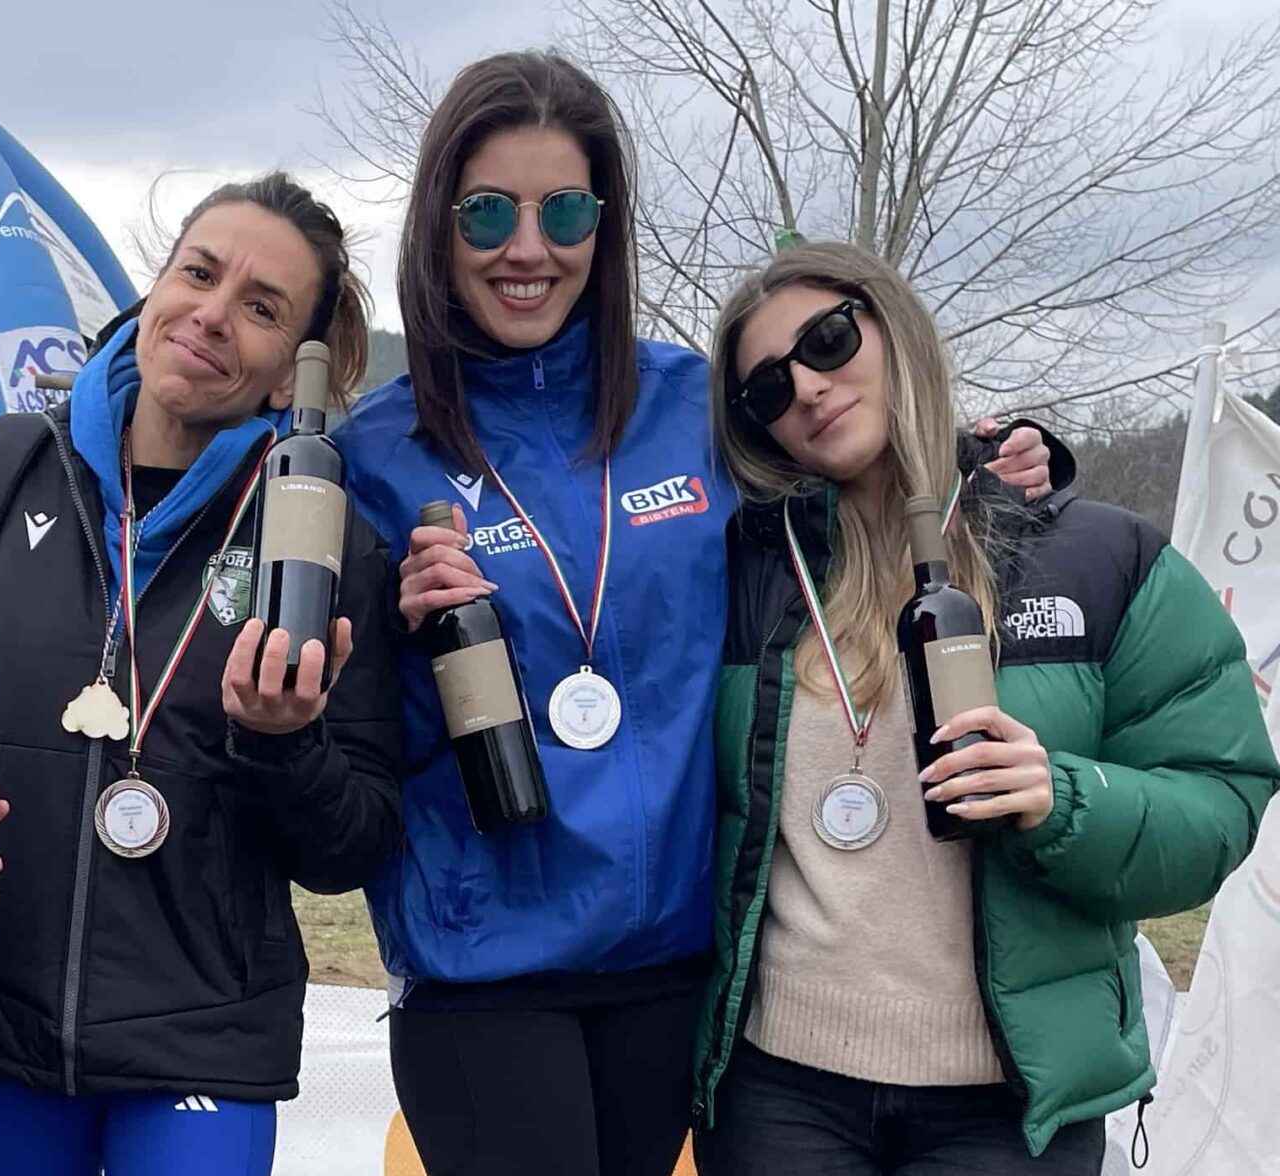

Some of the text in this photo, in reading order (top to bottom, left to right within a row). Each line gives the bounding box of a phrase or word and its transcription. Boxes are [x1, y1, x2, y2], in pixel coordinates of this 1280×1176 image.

[9, 337, 85, 388] ACS
[627, 474, 702, 511] BNK
[1021, 596, 1056, 612] THE
[1016, 623, 1057, 640] FACE
